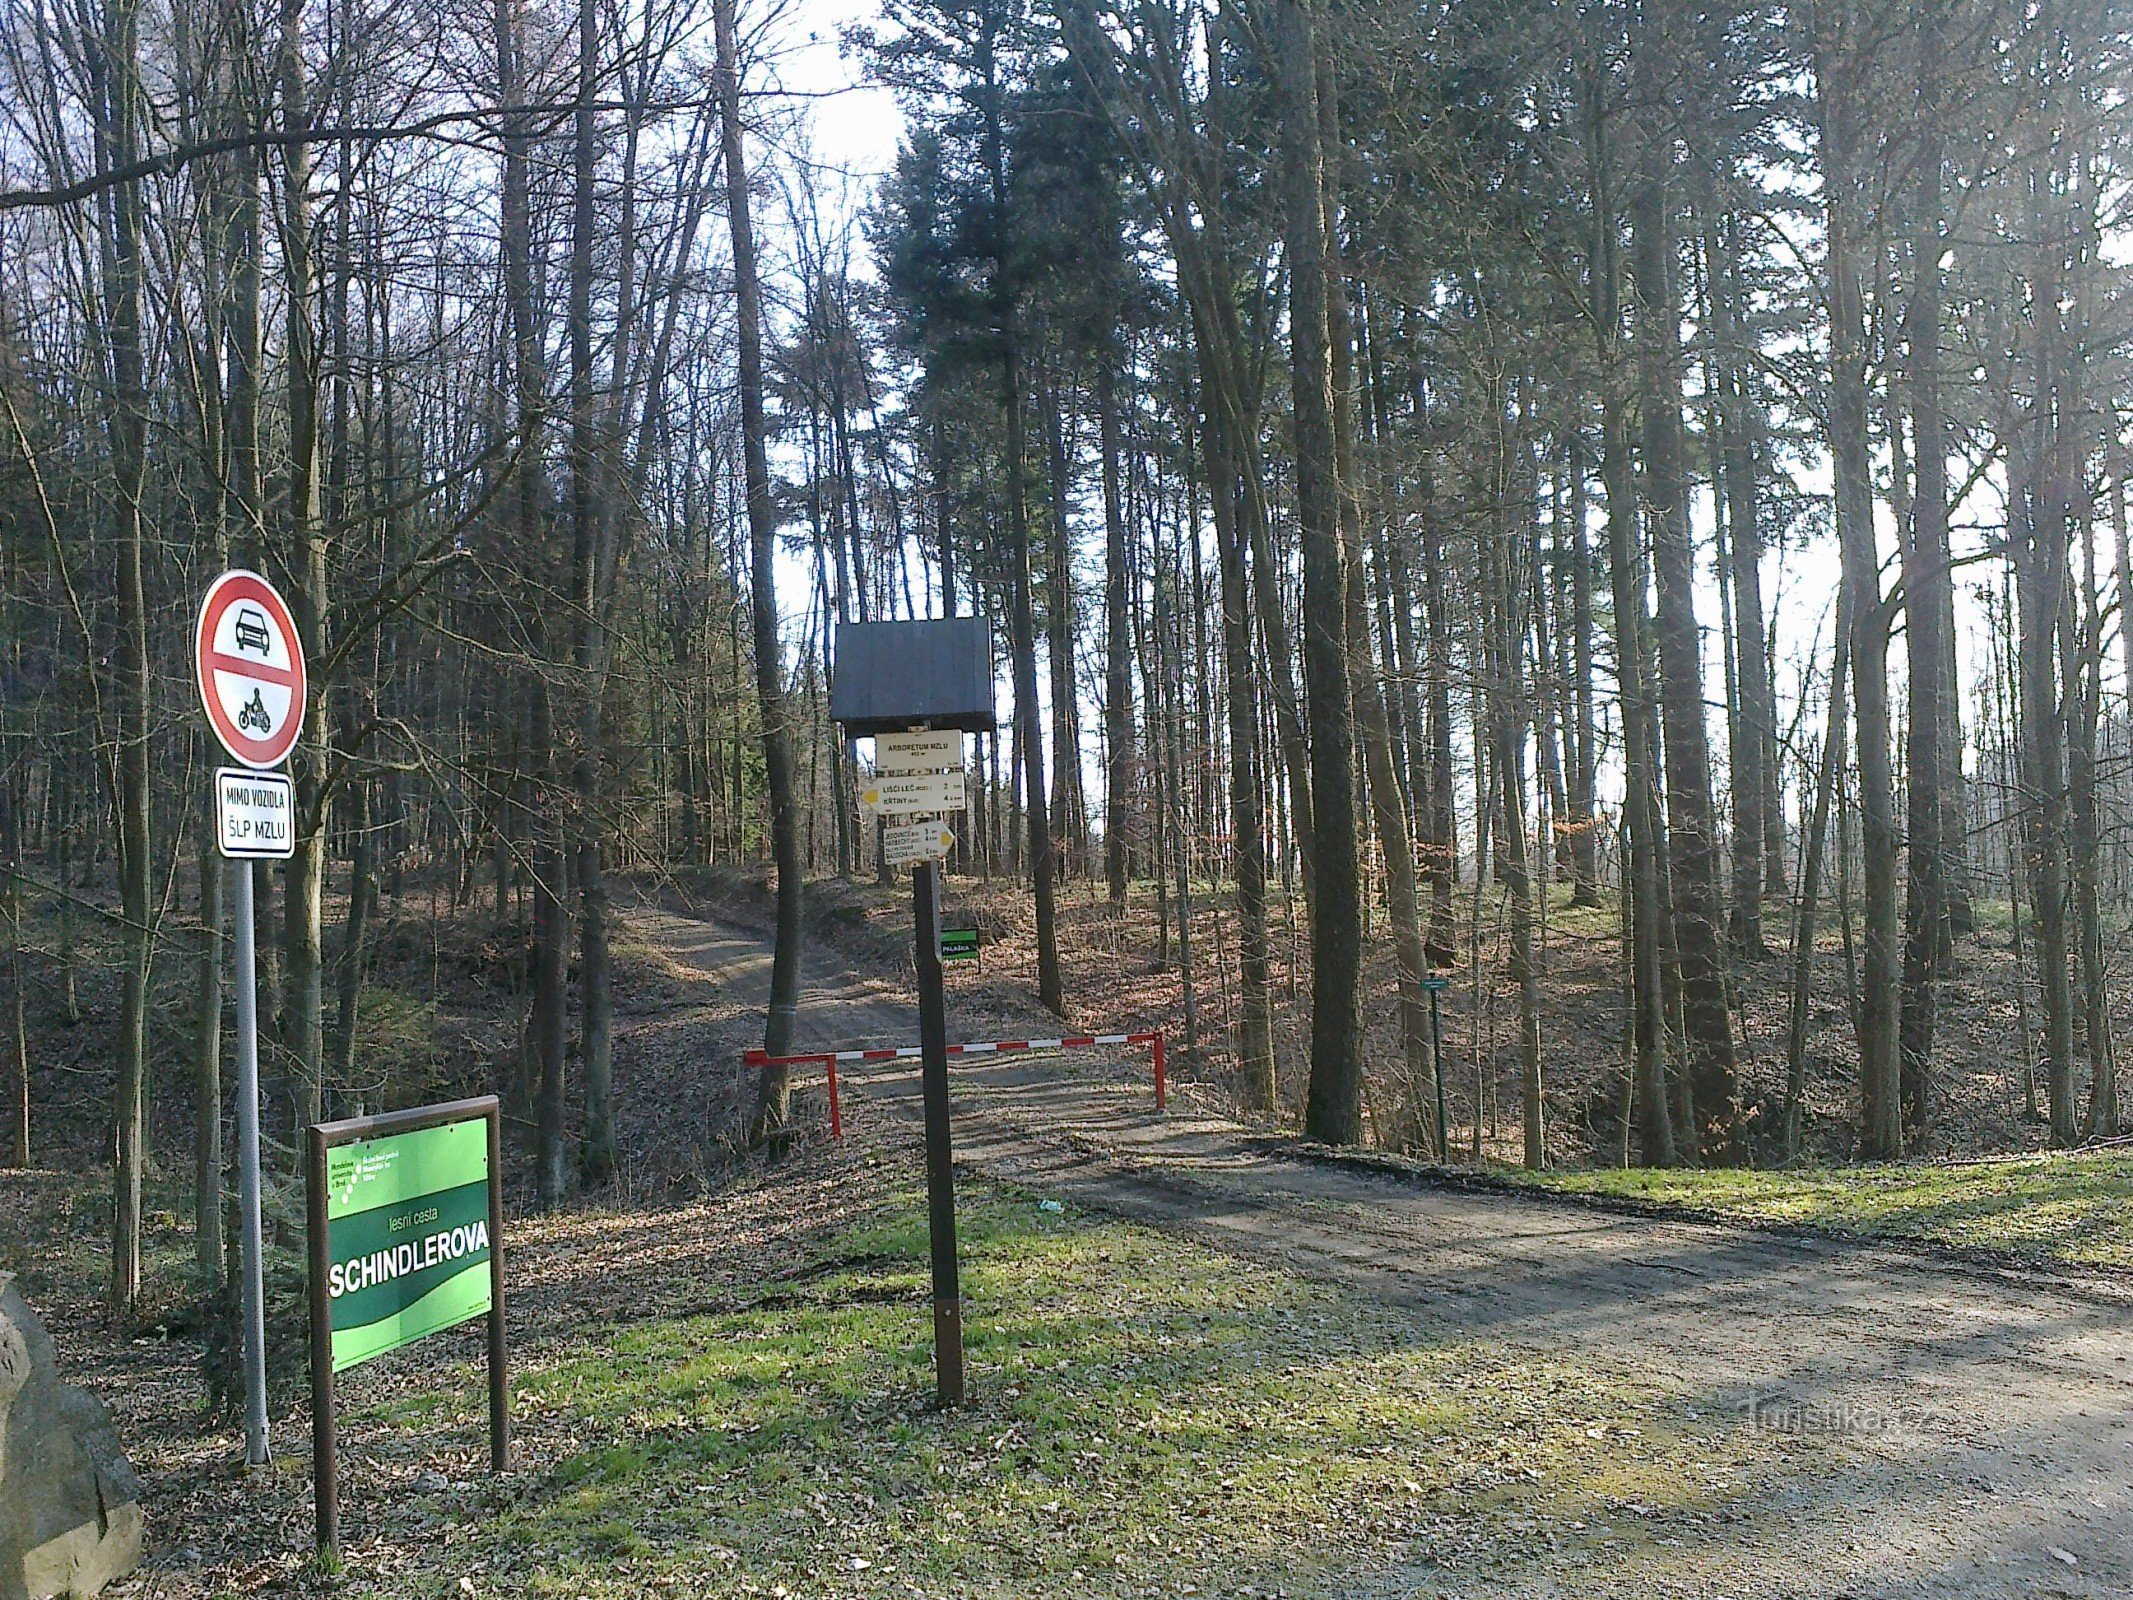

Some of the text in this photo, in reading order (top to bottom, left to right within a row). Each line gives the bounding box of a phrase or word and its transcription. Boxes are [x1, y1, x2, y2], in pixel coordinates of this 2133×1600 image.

[888, 742, 948, 752] ARBORETUM MZLU
[226, 786, 285, 809] MIMO VOZIDLA
[229, 815, 285, 839] ŠLP MZLU
[389, 1206, 438, 1232] lesní cesta
[328, 1220, 490, 1298] SCHINDLEROVA
